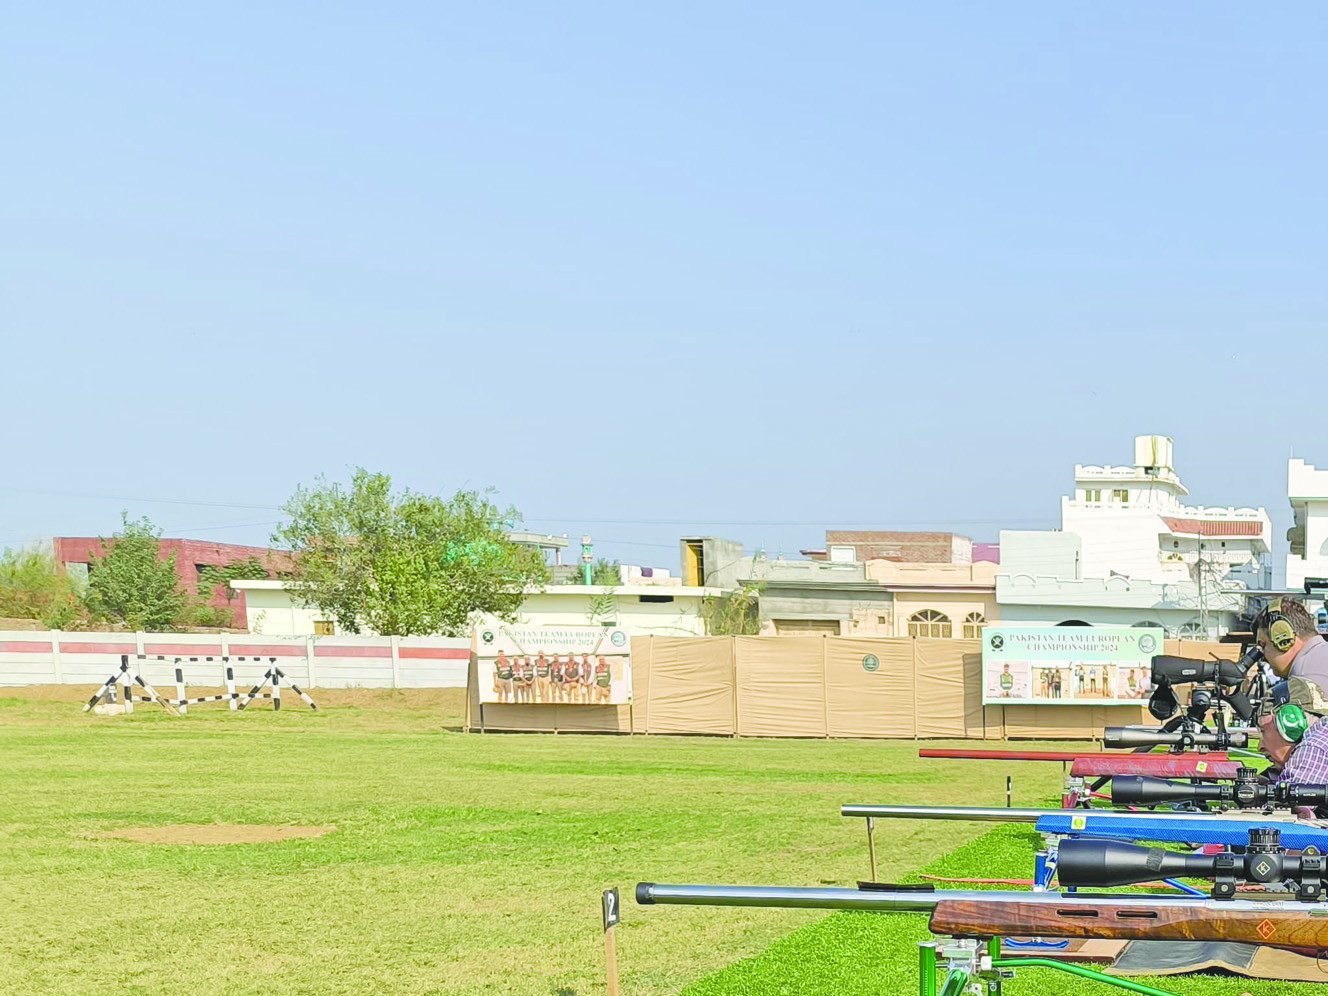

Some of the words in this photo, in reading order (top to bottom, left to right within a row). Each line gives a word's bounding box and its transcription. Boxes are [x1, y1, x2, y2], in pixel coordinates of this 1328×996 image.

[1009, 634, 1054, 642] PAKISTAN
[1057, 634, 1084, 642] TEAM
[1085, 634, 1136, 643] EUROPEAN
[1027, 643, 1099, 651] CHAMPIONSHIP
[1100, 644, 1119, 652] 2024
[607, 892, 616, 922] 2
